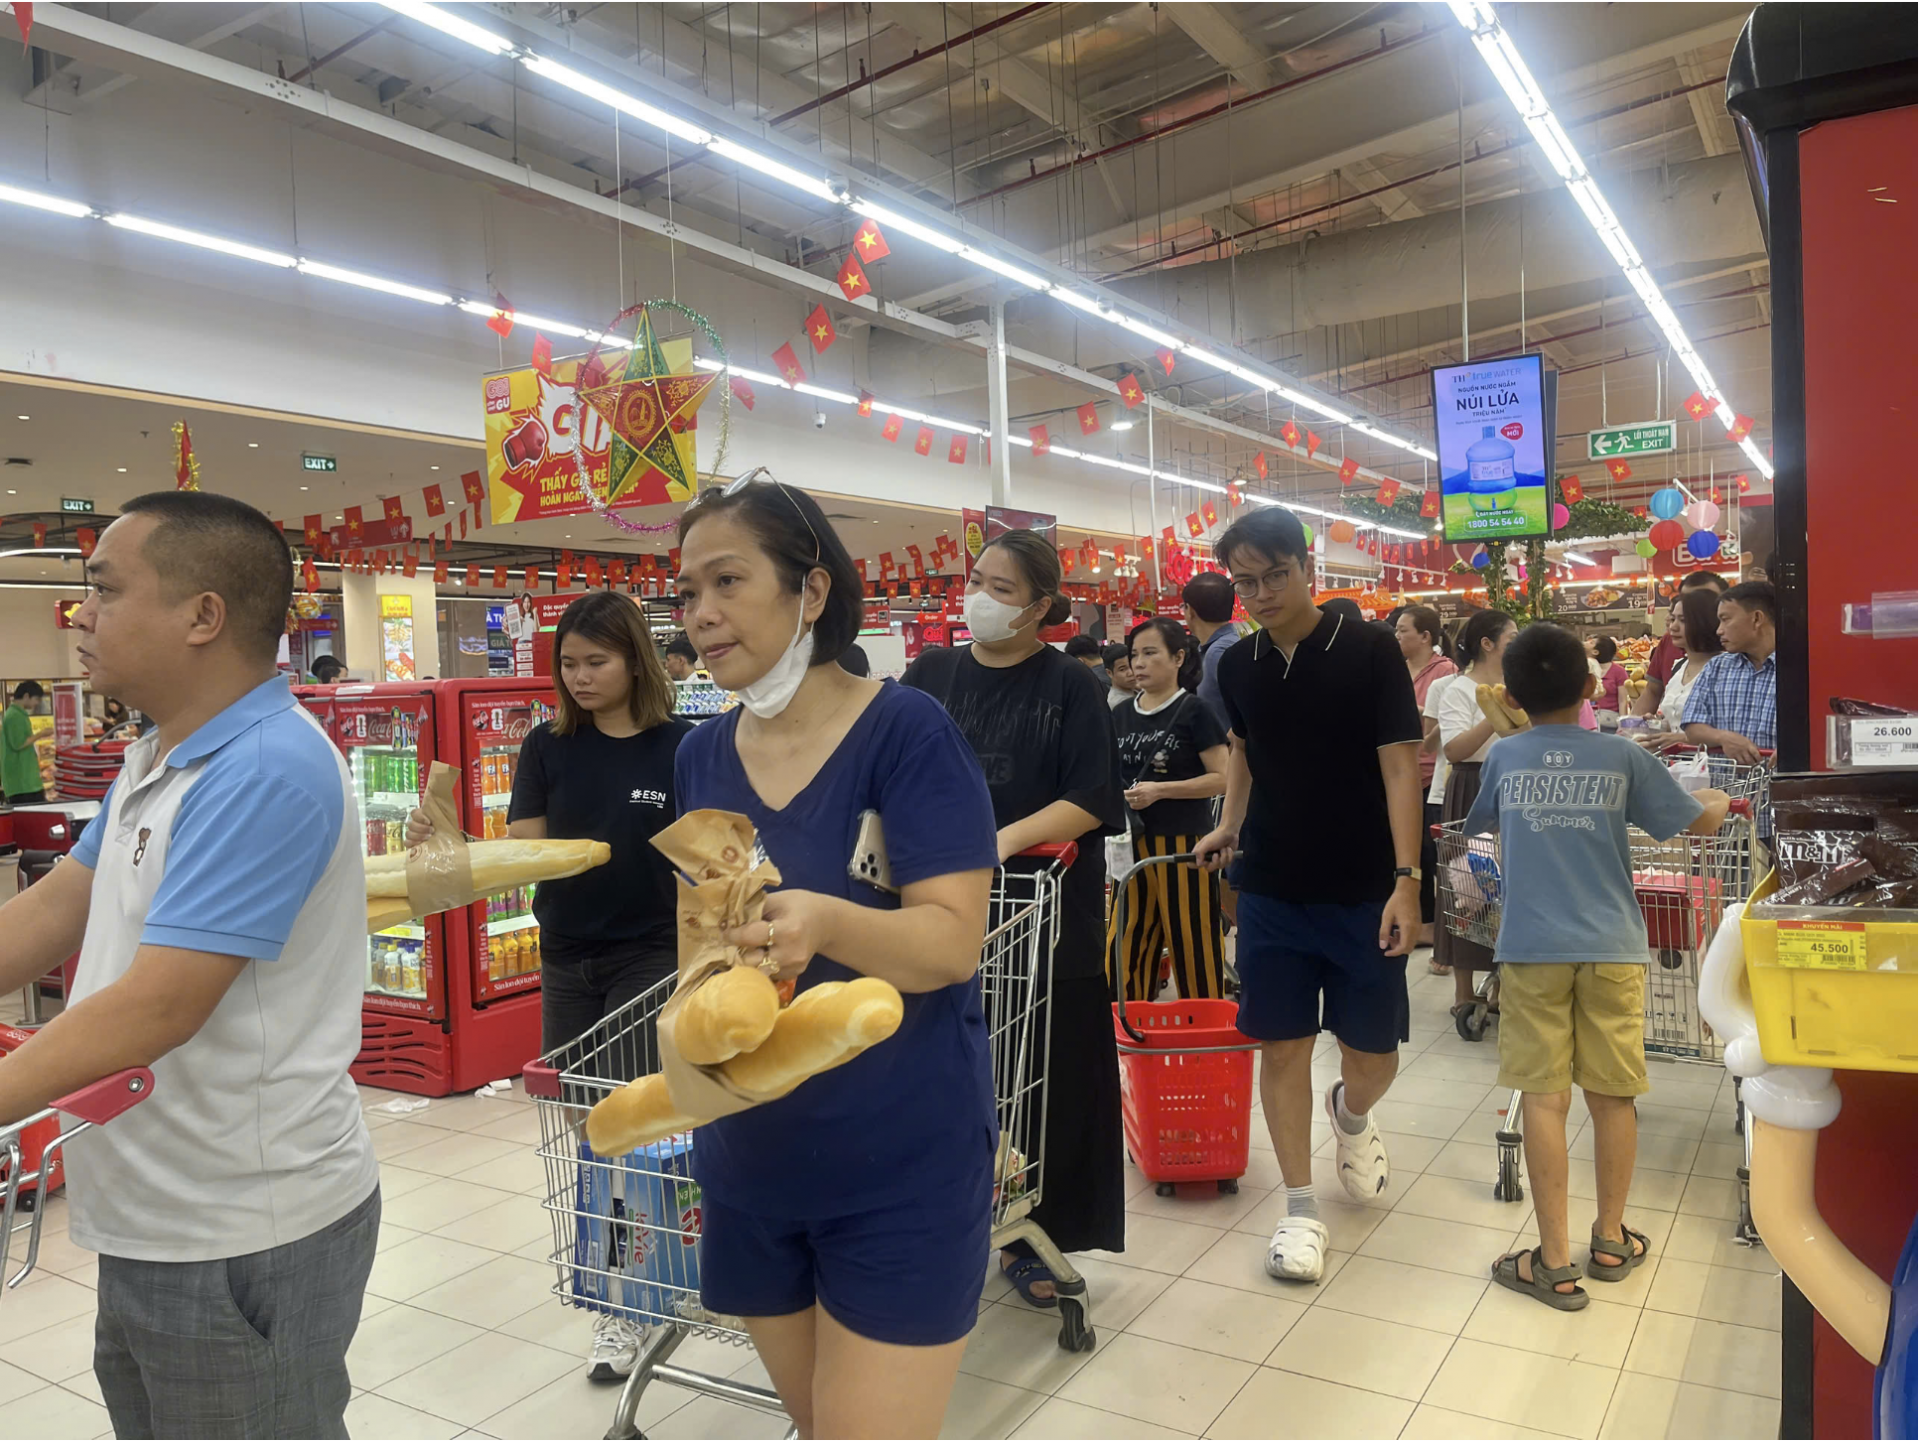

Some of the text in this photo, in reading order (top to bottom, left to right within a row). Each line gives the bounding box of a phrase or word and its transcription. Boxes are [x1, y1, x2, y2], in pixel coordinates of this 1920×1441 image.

[1472, 370, 1493, 381] true
[1494, 367, 1522, 378] WATER
[496, 397, 510, 411] GU
[1456, 389, 1520, 411] NÚI LỬA
[1642, 438, 1664, 449] EXIT
[304, 457, 327, 470] EXIT
[540, 466, 568, 493] THẤY
[593, 461, 607, 484] RẺ
[540, 491, 561, 507] HOÀN
[563, 489, 585, 503] NGAY
[63, 500, 85, 511] EXIT
[1467, 516, 1525, 529] 1800 54 54 40
[1628, 600, 1640, 609] 19
[1873, 726, 1912, 736] 26.600
[1546, 754, 1571, 763] BOY
[642, 790, 666, 802] ESN
[1500, 773, 1625, 808] PERSISTENT
[1522, 806, 1595, 833] Summer
[1810, 942, 1849, 954] 45.500
